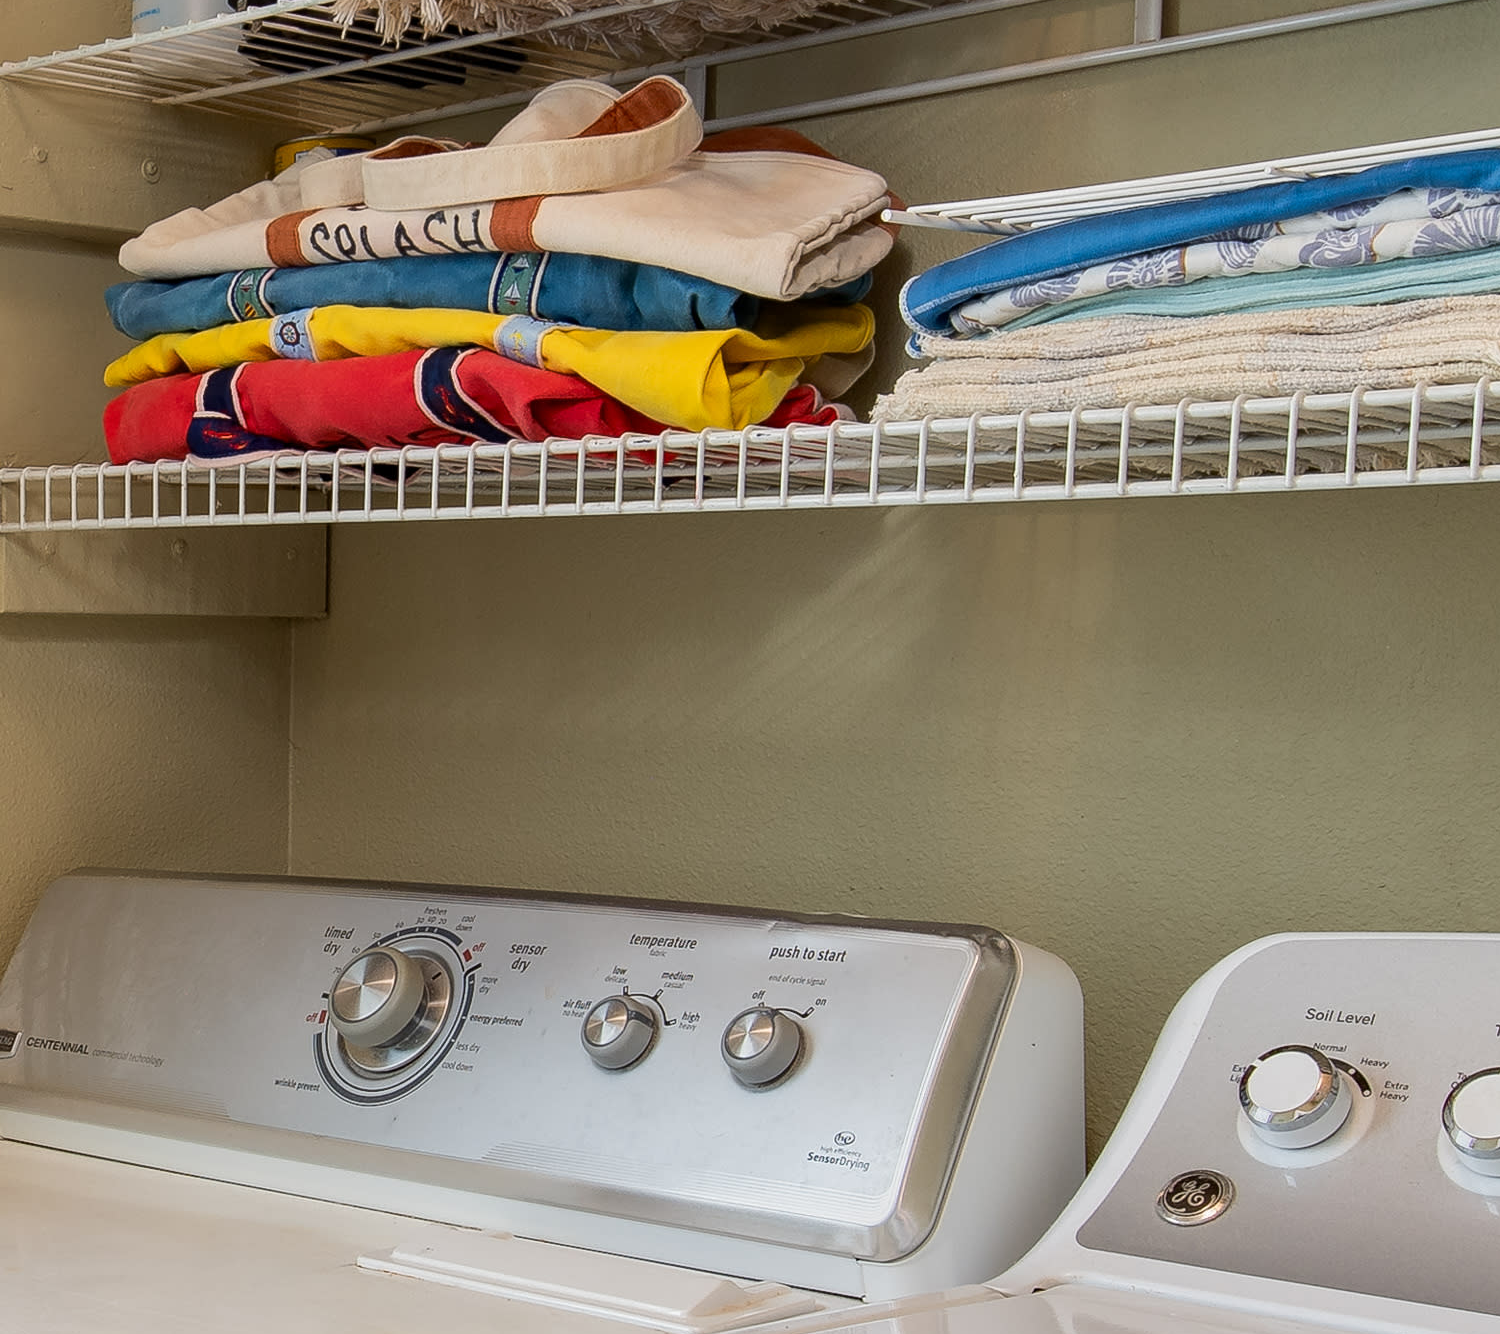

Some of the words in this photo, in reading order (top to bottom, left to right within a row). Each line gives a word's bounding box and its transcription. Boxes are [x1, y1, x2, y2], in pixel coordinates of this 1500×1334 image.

[324, 926, 355, 940] timed
[472, 941, 488, 953] off
[629, 933, 699, 950] temperature
[323, 941, 341, 956] dry
[508, 942, 548, 956] sensor
[768, 945, 800, 960] push
[802, 947, 815, 960] to
[817, 949, 847, 963] start
[511, 957, 532, 973] dry
[612, 965, 629, 975] low
[661, 971, 695, 982] medium
[752, 990, 767, 1000] off
[815, 997, 827, 1007] on
[305, 1012, 319, 1023] off
[681, 1010, 701, 1024] high
[1305, 1008, 1334, 1022] Soil
[1336, 1010, 1376, 1026] Level
[25, 1036, 90, 1056] CENTENNIAL
[1312, 1042, 1348, 1053] Normal
[1359, 1057, 1390, 1069] Heavy
[1384, 1080, 1410, 1091] Extra
[1379, 1091, 1410, 1103] Heavy
[807, 1152, 871, 1173] SensorDrying
